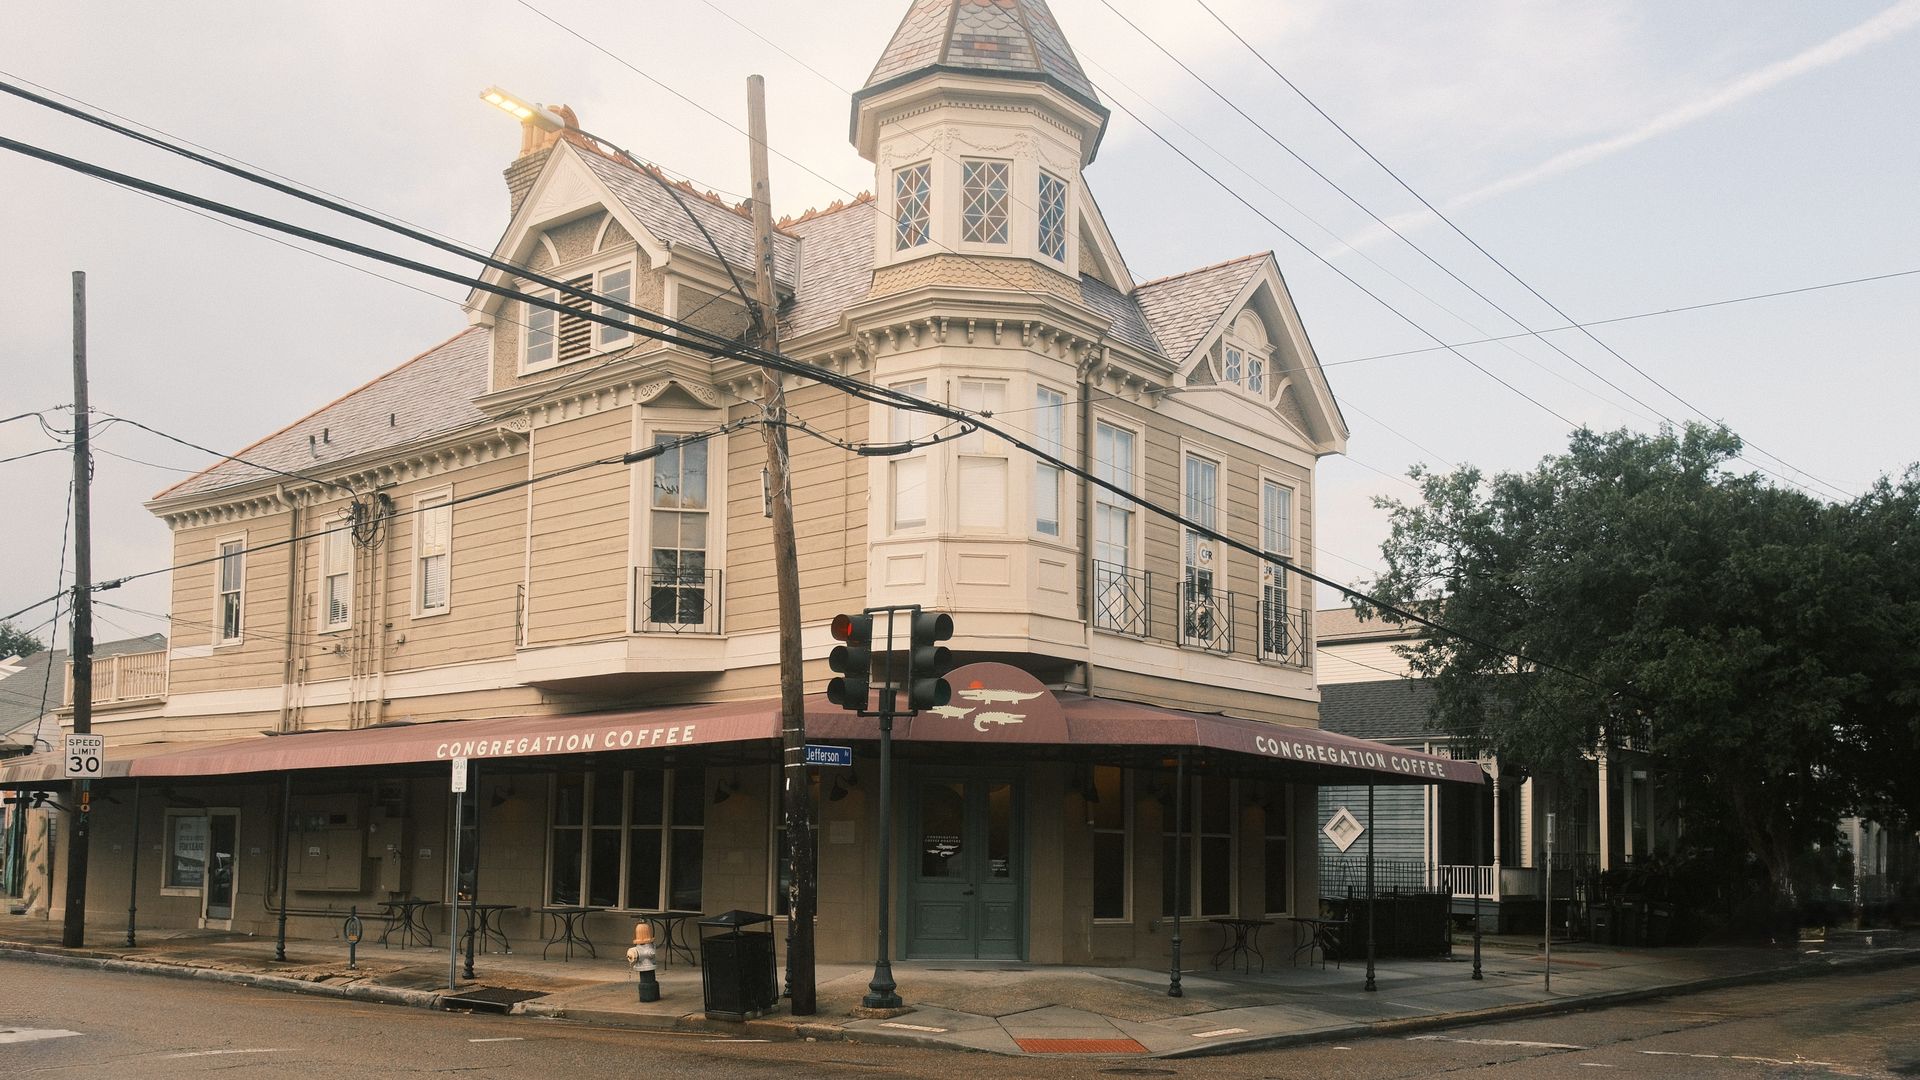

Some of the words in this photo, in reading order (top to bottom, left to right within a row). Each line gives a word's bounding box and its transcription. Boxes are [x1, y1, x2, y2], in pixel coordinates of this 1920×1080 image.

[68, 739, 101, 747] SPEED
[436, 733, 595, 759] CONGREGATION
[604, 725, 696, 748] COFFEE
[806, 747, 840, 762] Jefferson
[1255, 735, 1387, 769] CONGREGATION
[1391, 755, 1446, 778] COFFEE
[69, 756, 100, 773] 30
